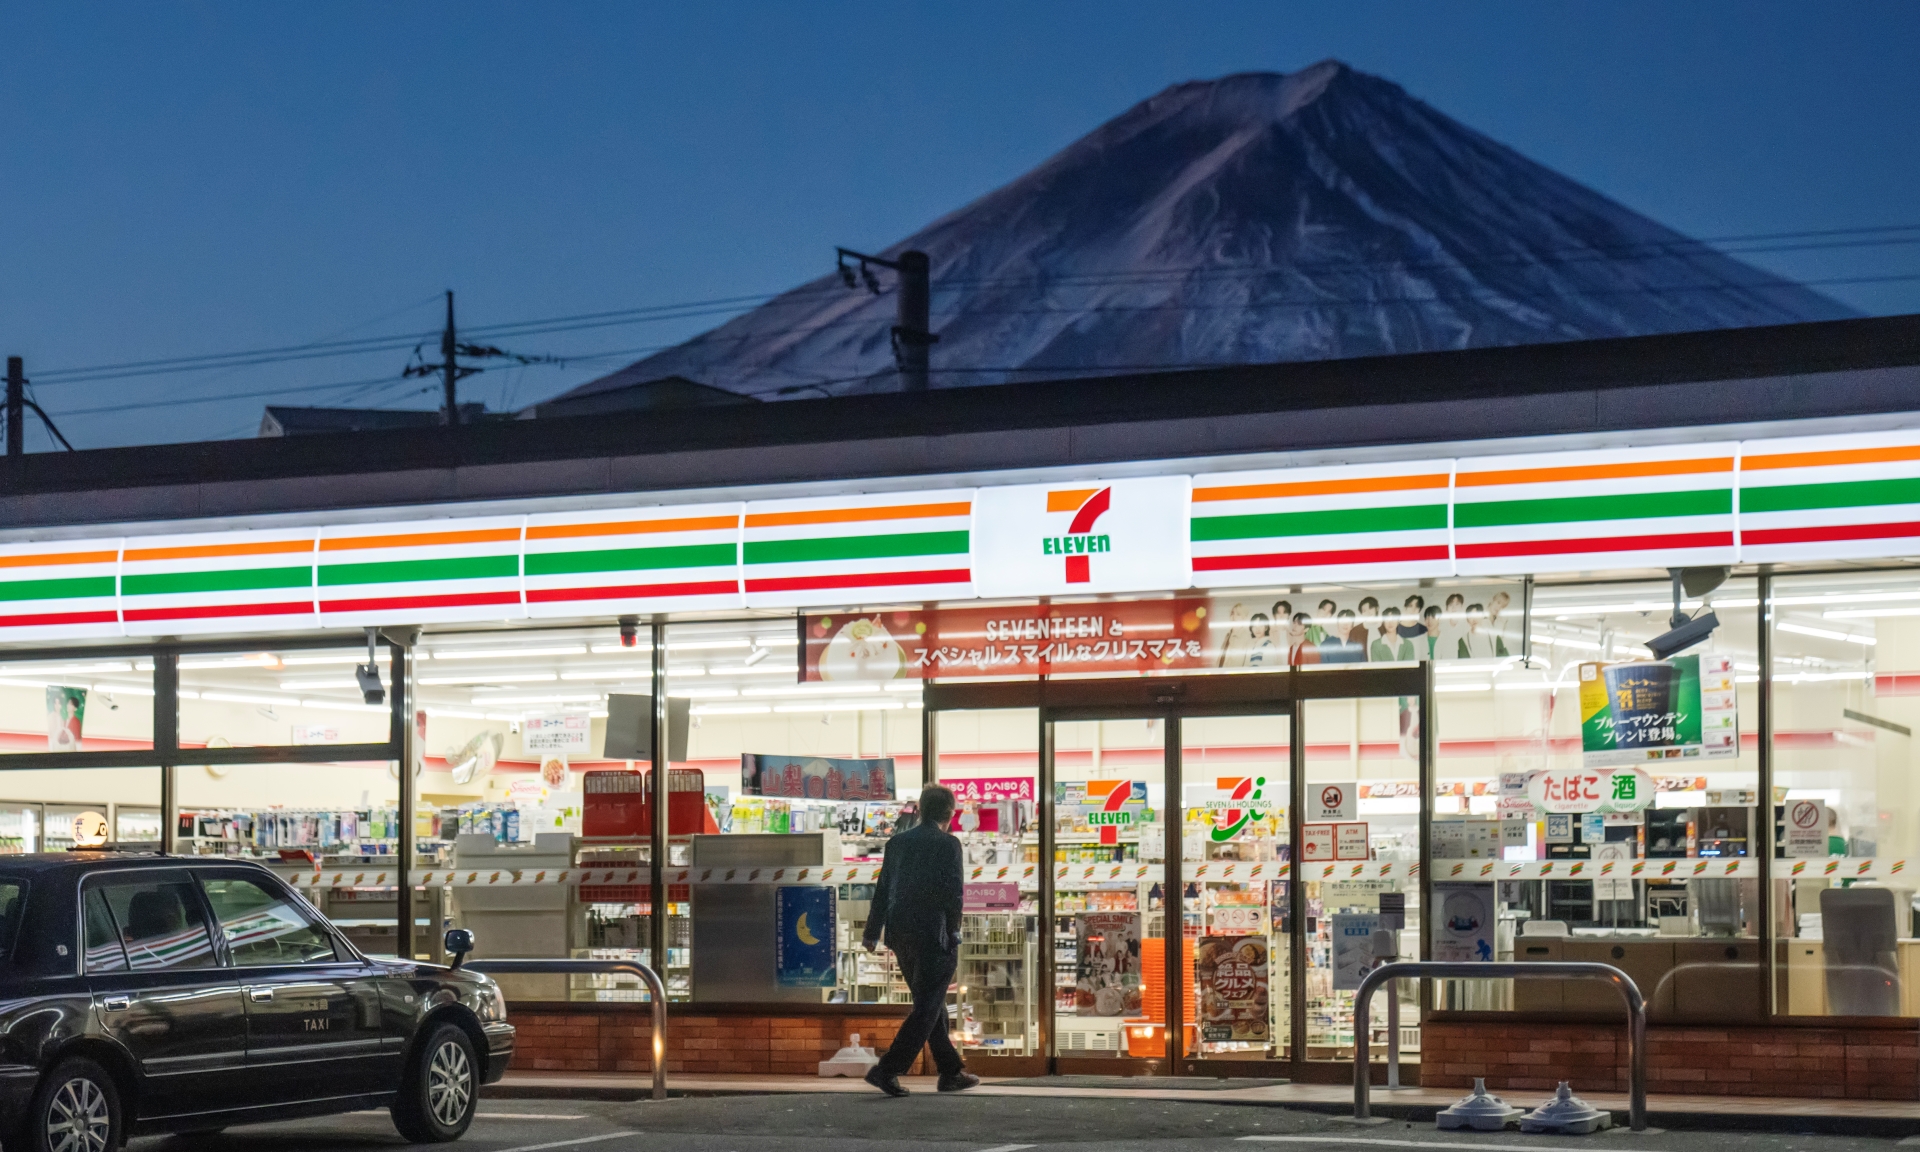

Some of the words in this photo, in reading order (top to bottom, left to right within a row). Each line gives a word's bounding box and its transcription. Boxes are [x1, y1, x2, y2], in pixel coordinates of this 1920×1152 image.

[985, 616, 1103, 642] SEVENTEEN
[1108, 620, 1124, 637] と
[913, 639, 1201, 667] スペシャルスマイルなクリスマスを
[1594, 712, 1688, 731] ブルーマウンテン
[1602, 727, 1683, 745] ブレンド登場。
[984, 782, 1018, 791] DAISO
[1543, 774, 1600, 801] たばこ
[1612, 774, 1637, 800] 酒
[1205, 801, 1227, 809] SEVEN
[1236, 800, 1272, 808] HOLDINGS
[1554, 802, 1588, 811] cigarette
[1614, 801, 1637, 810] liquor
[1083, 915, 1111, 925] SPECIAL
[1112, 915, 1133, 925] SMILE
[1216, 963, 1251, 977] 絶品
[1215, 978, 1253, 990] グルメ
[1222, 990, 1248, 998] フェア
[303, 1018, 329, 1031] TAXI
